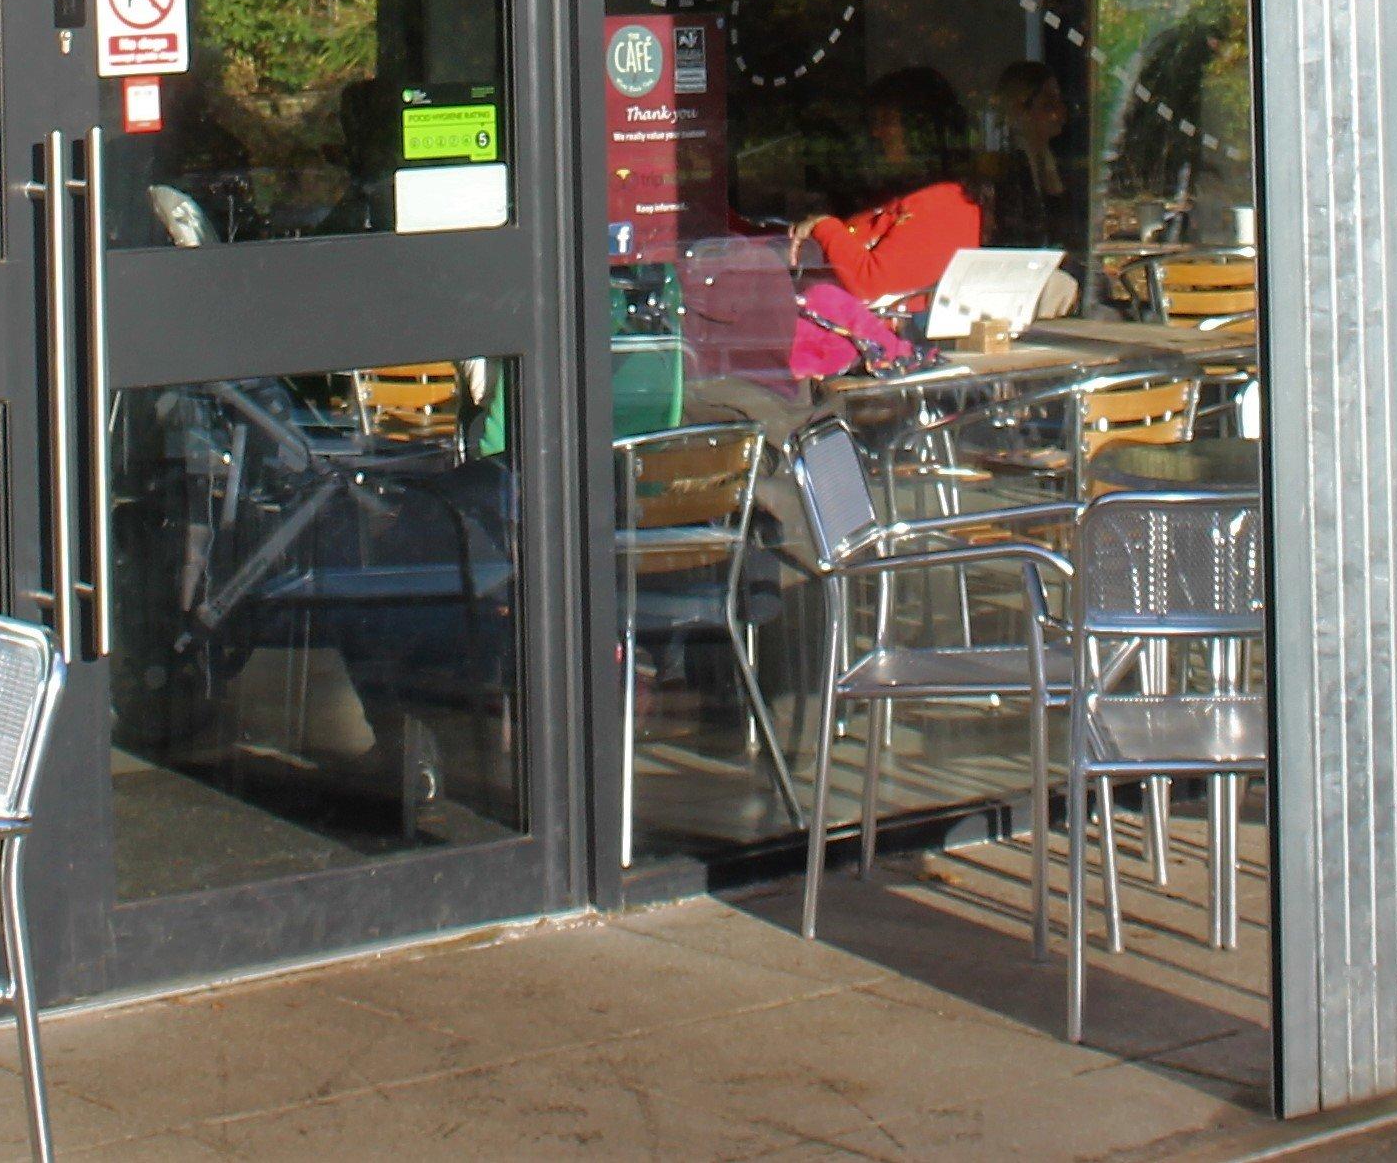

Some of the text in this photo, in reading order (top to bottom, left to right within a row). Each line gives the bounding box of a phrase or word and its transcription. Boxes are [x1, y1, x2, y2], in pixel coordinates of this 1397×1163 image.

[626, 105, 698, 123] Thank you
[478, 132, 487, 146] 5
